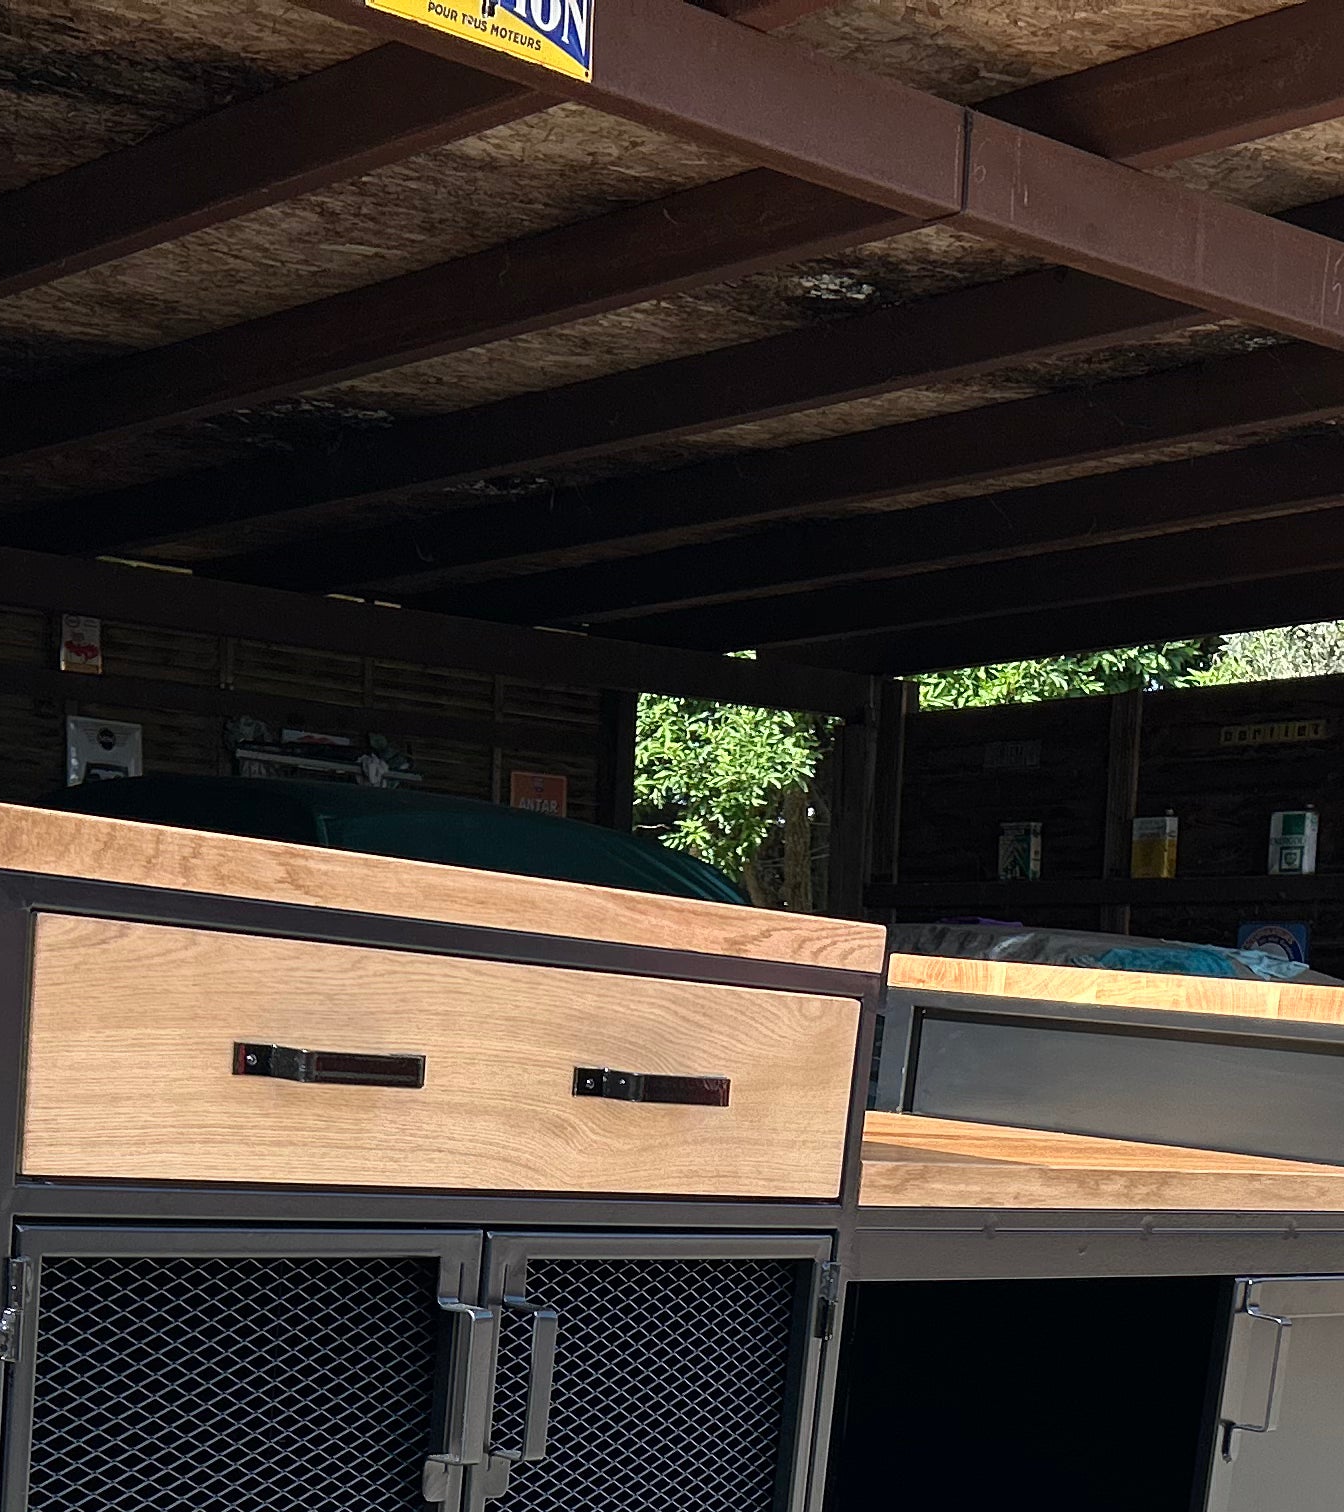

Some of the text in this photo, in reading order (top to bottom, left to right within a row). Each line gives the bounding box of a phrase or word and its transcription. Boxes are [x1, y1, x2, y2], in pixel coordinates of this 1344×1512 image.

[428, 1, 542, 51] POUR TOUS MOTEURS
